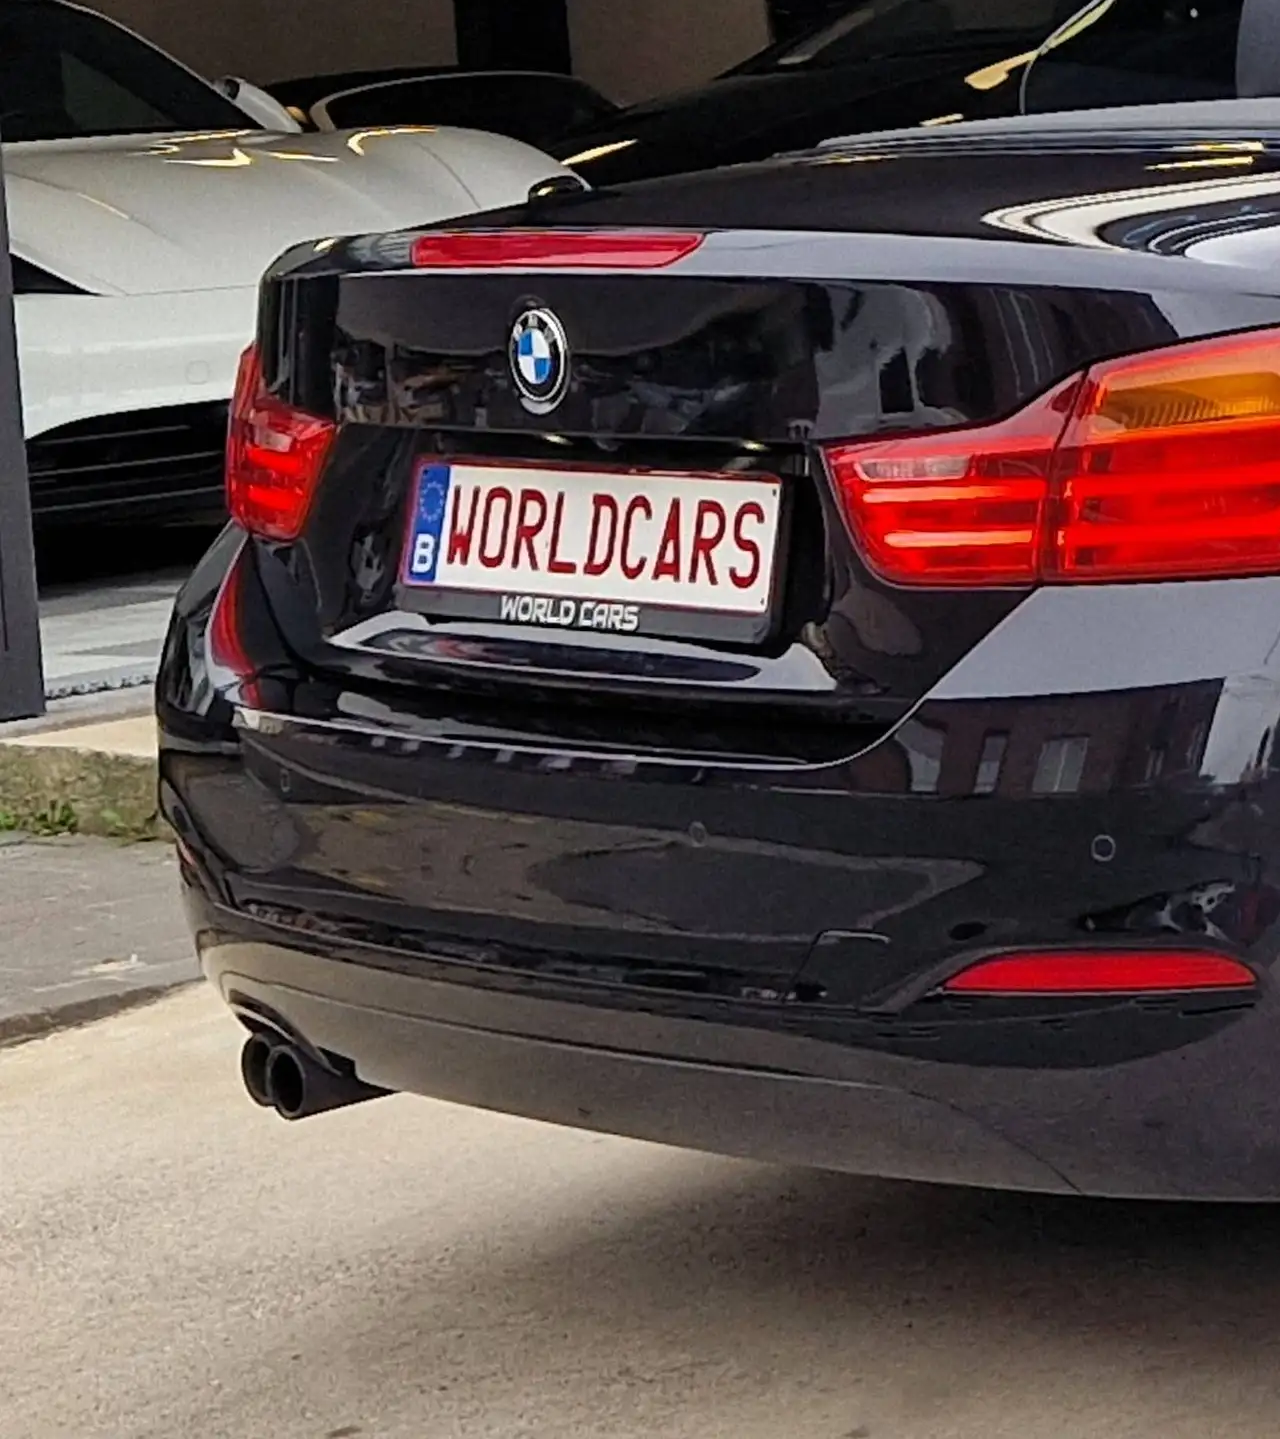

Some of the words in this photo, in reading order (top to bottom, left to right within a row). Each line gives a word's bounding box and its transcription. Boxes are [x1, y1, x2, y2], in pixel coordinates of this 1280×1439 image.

[410, 533, 435, 574] B
[446, 485, 766, 589] WORLDCARS
[500, 595, 576, 625] WORLD
[577, 599, 640, 632] CARS
